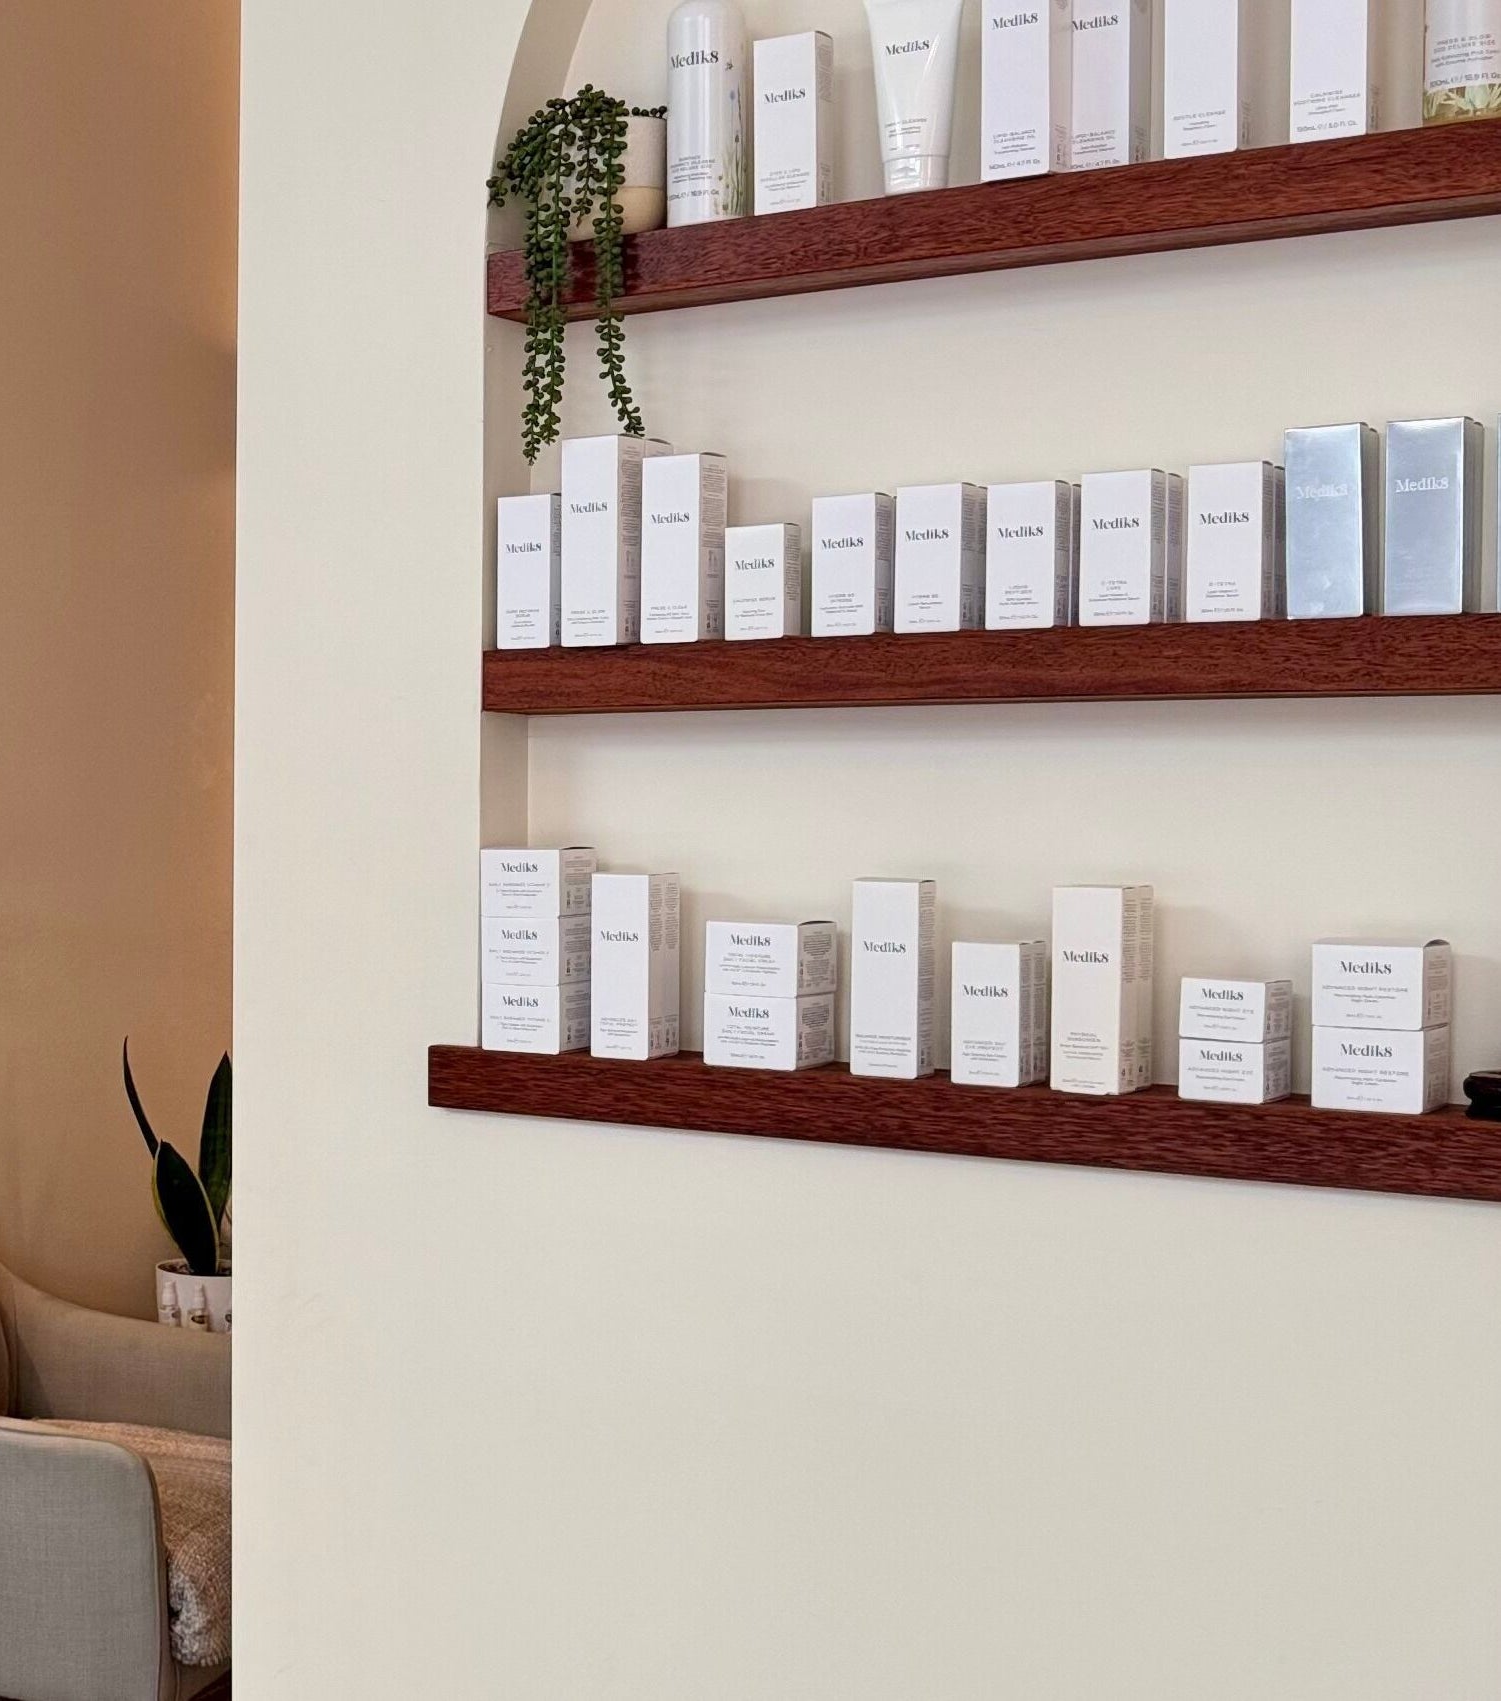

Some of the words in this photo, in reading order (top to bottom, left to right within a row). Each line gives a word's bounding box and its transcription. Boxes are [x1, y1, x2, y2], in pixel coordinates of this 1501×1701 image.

[992, 12, 1039, 31] Medik8
[1072, 14, 1119, 32] Medik8
[885, 39, 930, 56] Medik8
[671, 50, 719, 70] Medik8
[763, 88, 806, 105] Medik8
[1395, 476, 1449, 493] Medik8
[570, 502, 608, 514] Medik8
[650, 512, 690, 525] Medik8
[1092, 516, 1140, 531] Medik8
[1200, 511, 1250, 525] Medik8
[905, 528, 949, 542] Medik8
[998, 525, 1044, 539] Medik8
[505, 542, 542, 554] Medik8
[821, 536, 864, 550] Medik8
[734, 558, 775, 571] Medik8
[500, 862, 539, 873] Medik8
[501, 929, 538, 941] Medik8
[600, 930, 639, 942] Medik8
[729, 933, 771, 947] Medik8
[862, 940, 906, 954] Medik8
[1062, 950, 1109, 964] Medik8
[1340, 960, 1392, 976] Medik8
[962, 984, 1009, 998] Medik8
[1201, 987, 1244, 1002] Medik8
[502, 995, 539, 1007] Medik8
[727, 1005, 770, 1019] Medik8
[1199, 1049, 1243, 1063] Medik8
[1340, 1043, 1393, 1059] Medik8
